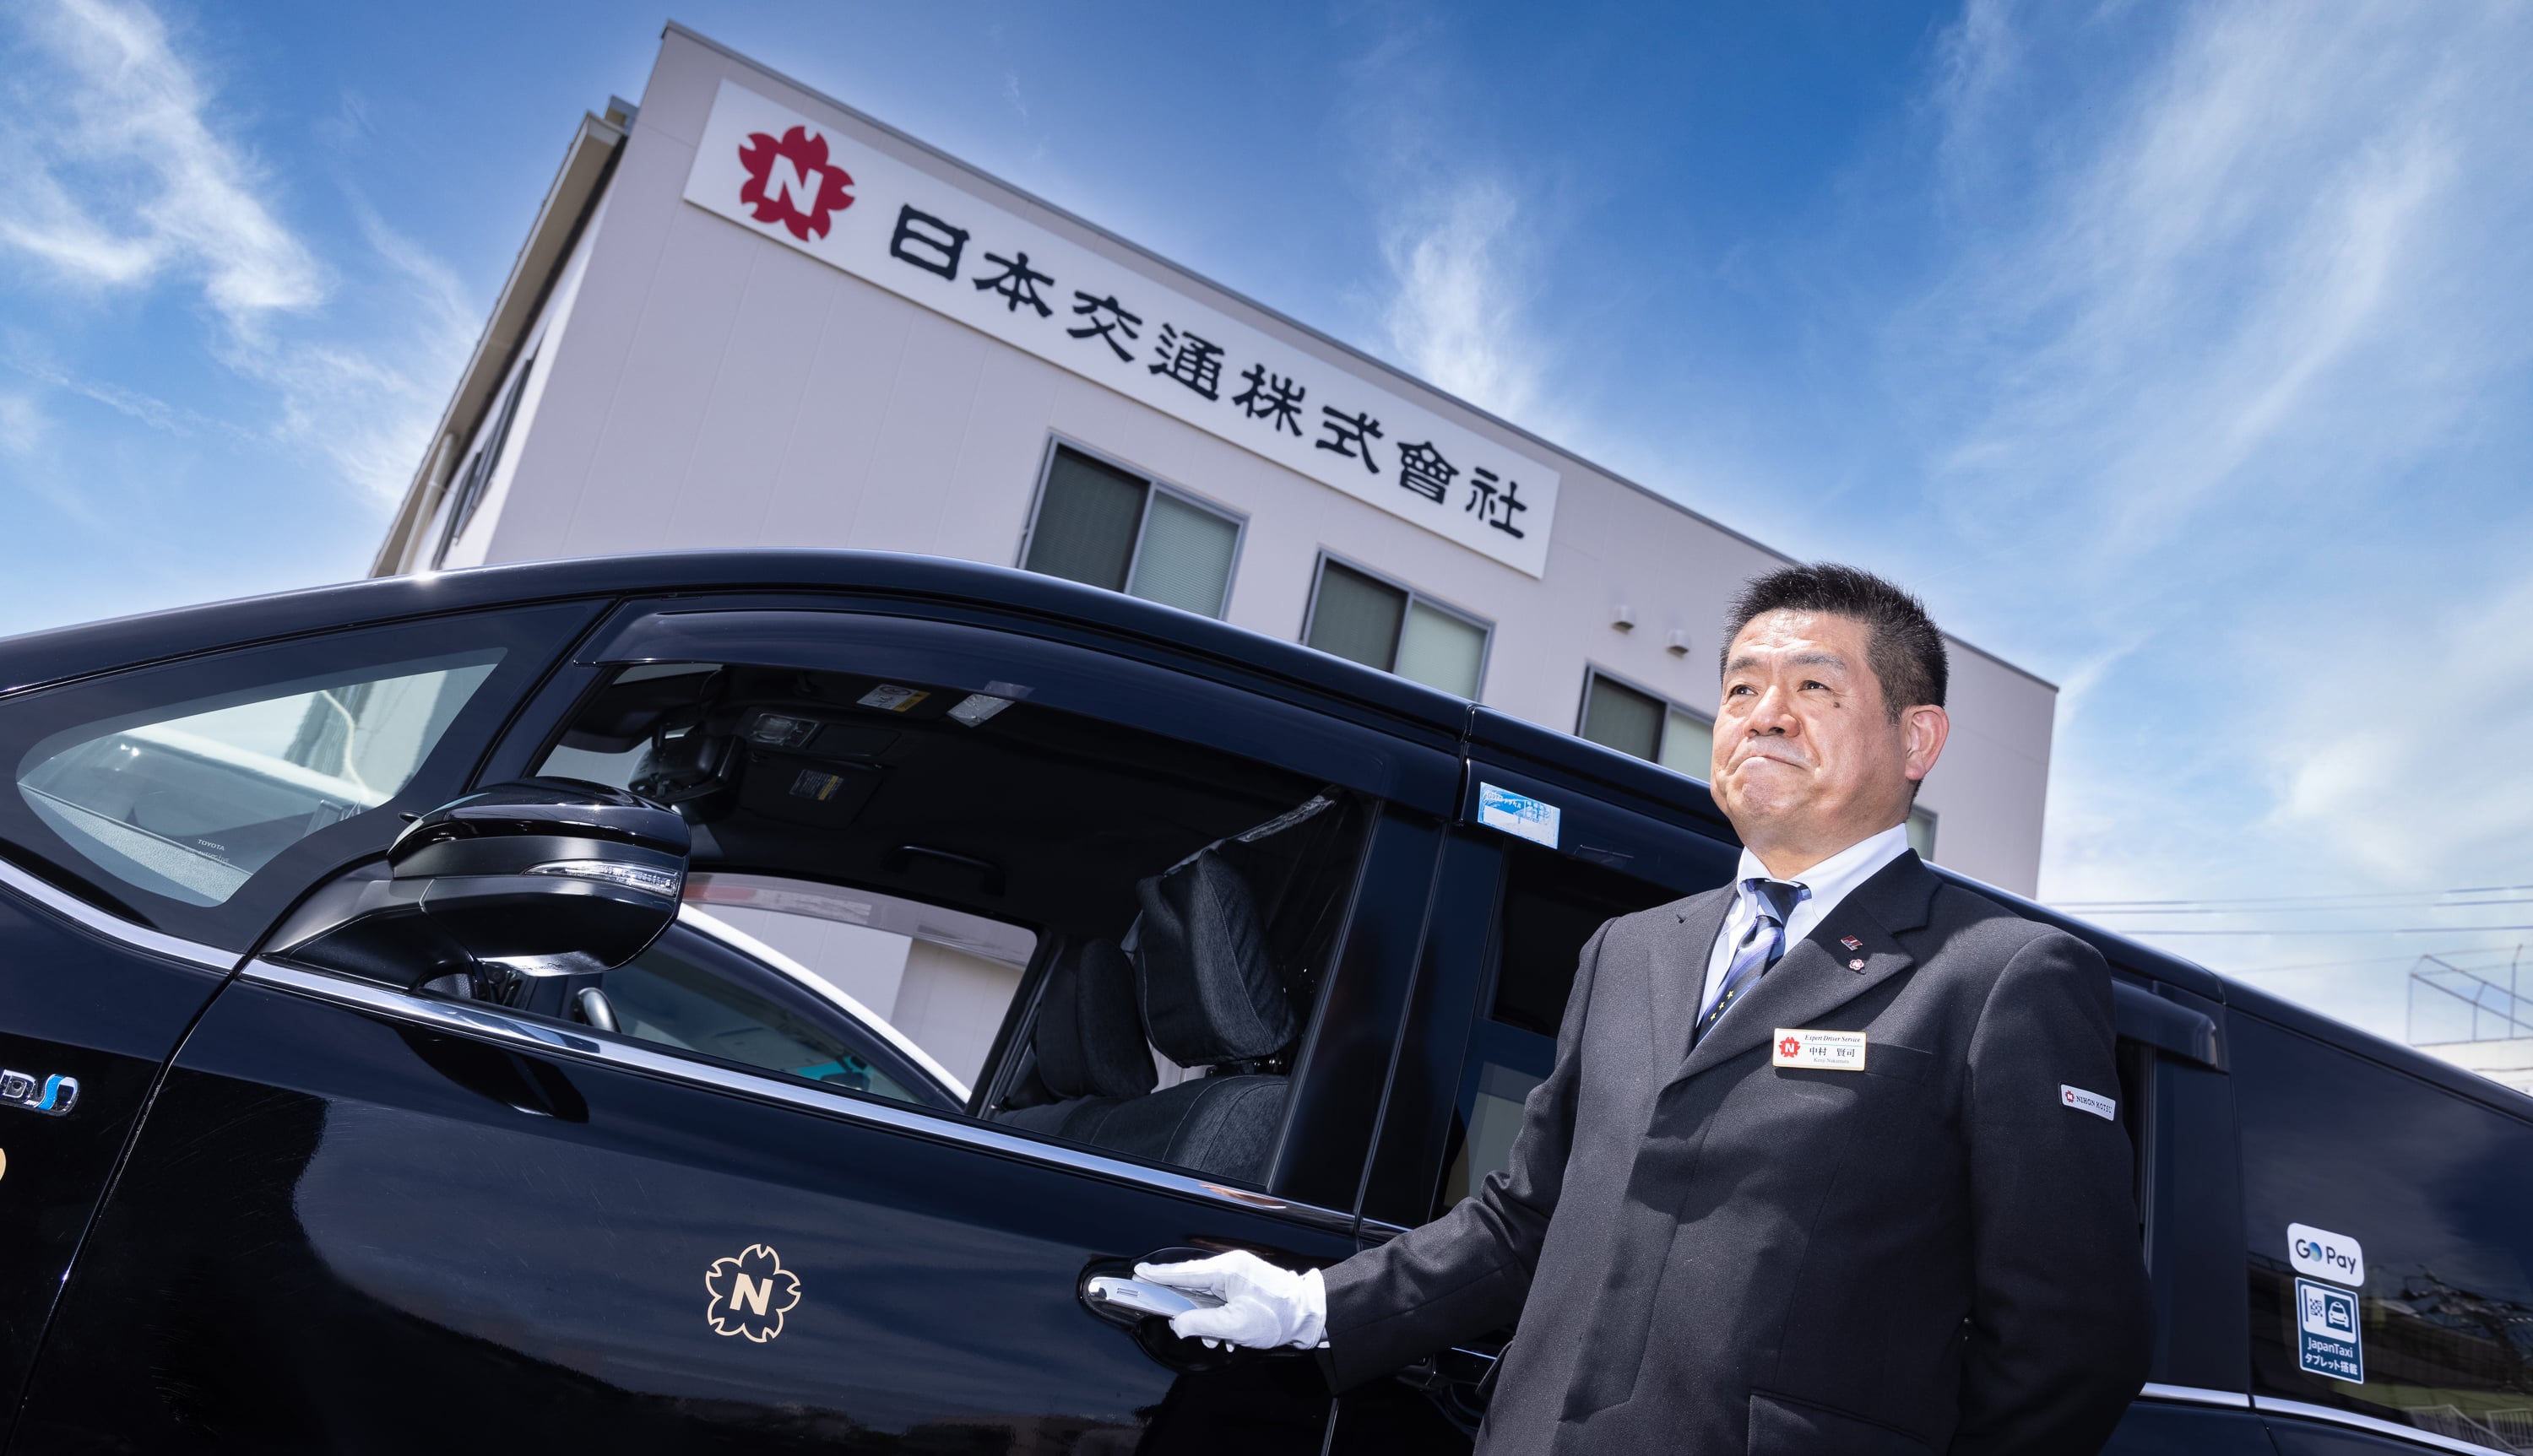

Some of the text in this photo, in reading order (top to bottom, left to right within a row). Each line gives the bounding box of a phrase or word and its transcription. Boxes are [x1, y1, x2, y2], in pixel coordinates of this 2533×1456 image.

[763, 153, 824, 217] N
[890, 203, 1527, 539] 日本交通株式會社
[198, 838, 225, 851] TOYOTA
[1809, 1047, 1826, 1056] 中村
[2076, 1096, 2095, 1107] NIHON
[2325, 1246, 2356, 1275] Pay
[730, 1272, 773, 1316] N
[2308, 1337, 2353, 1358] JapanTaxi
[2305, 1352, 2358, 1376] タブレット搭載
